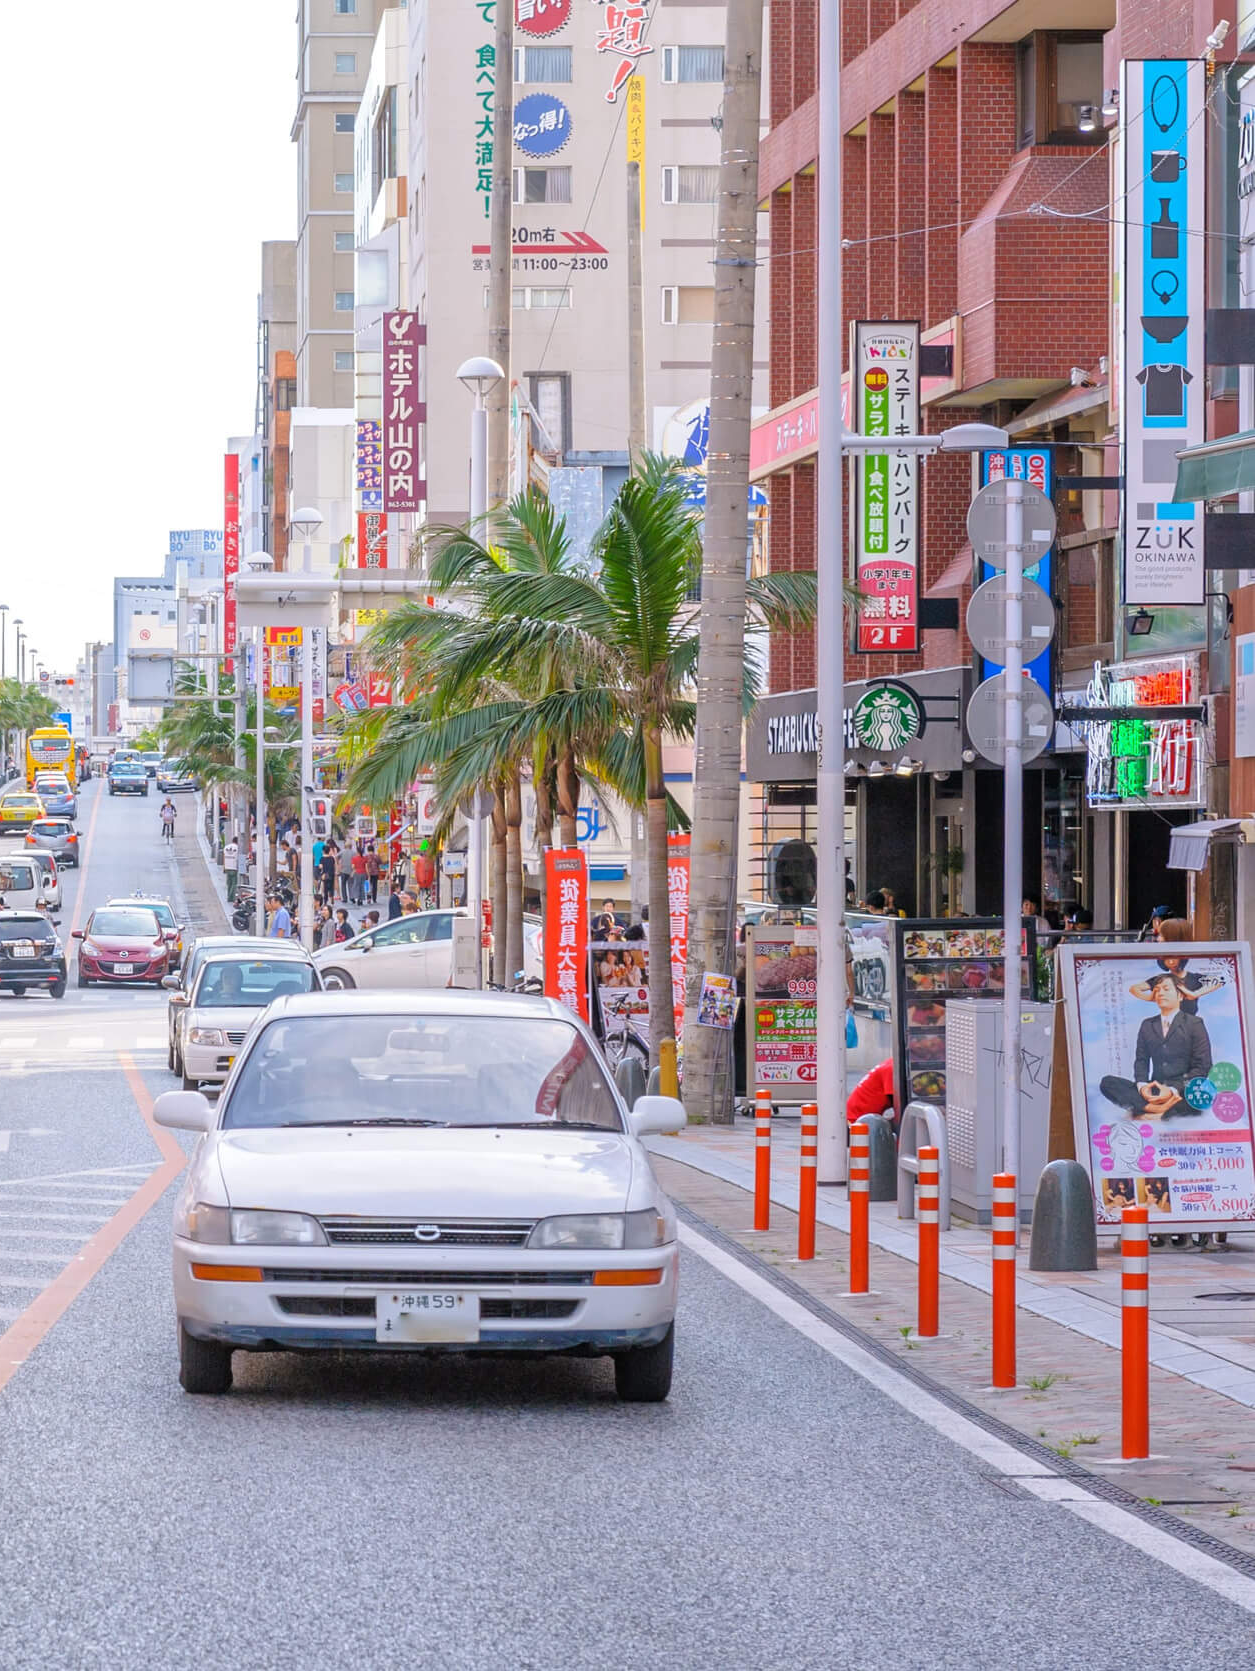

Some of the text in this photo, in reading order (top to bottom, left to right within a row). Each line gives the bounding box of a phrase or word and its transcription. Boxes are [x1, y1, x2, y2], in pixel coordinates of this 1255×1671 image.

[388, 349, 414, 498] ホテル山の内
[869, 394, 884, 550] サラダー食べ放題付
[894, 368, 911, 554] ステーキハンバーグ
[169, 530, 223, 541] RYU RYU
[169, 541, 217, 552] BO BO
[225, 519, 239, 601] おきな屋
[1135, 553, 1196, 562] OKINAWA
[871, 627, 903, 645] 2F
